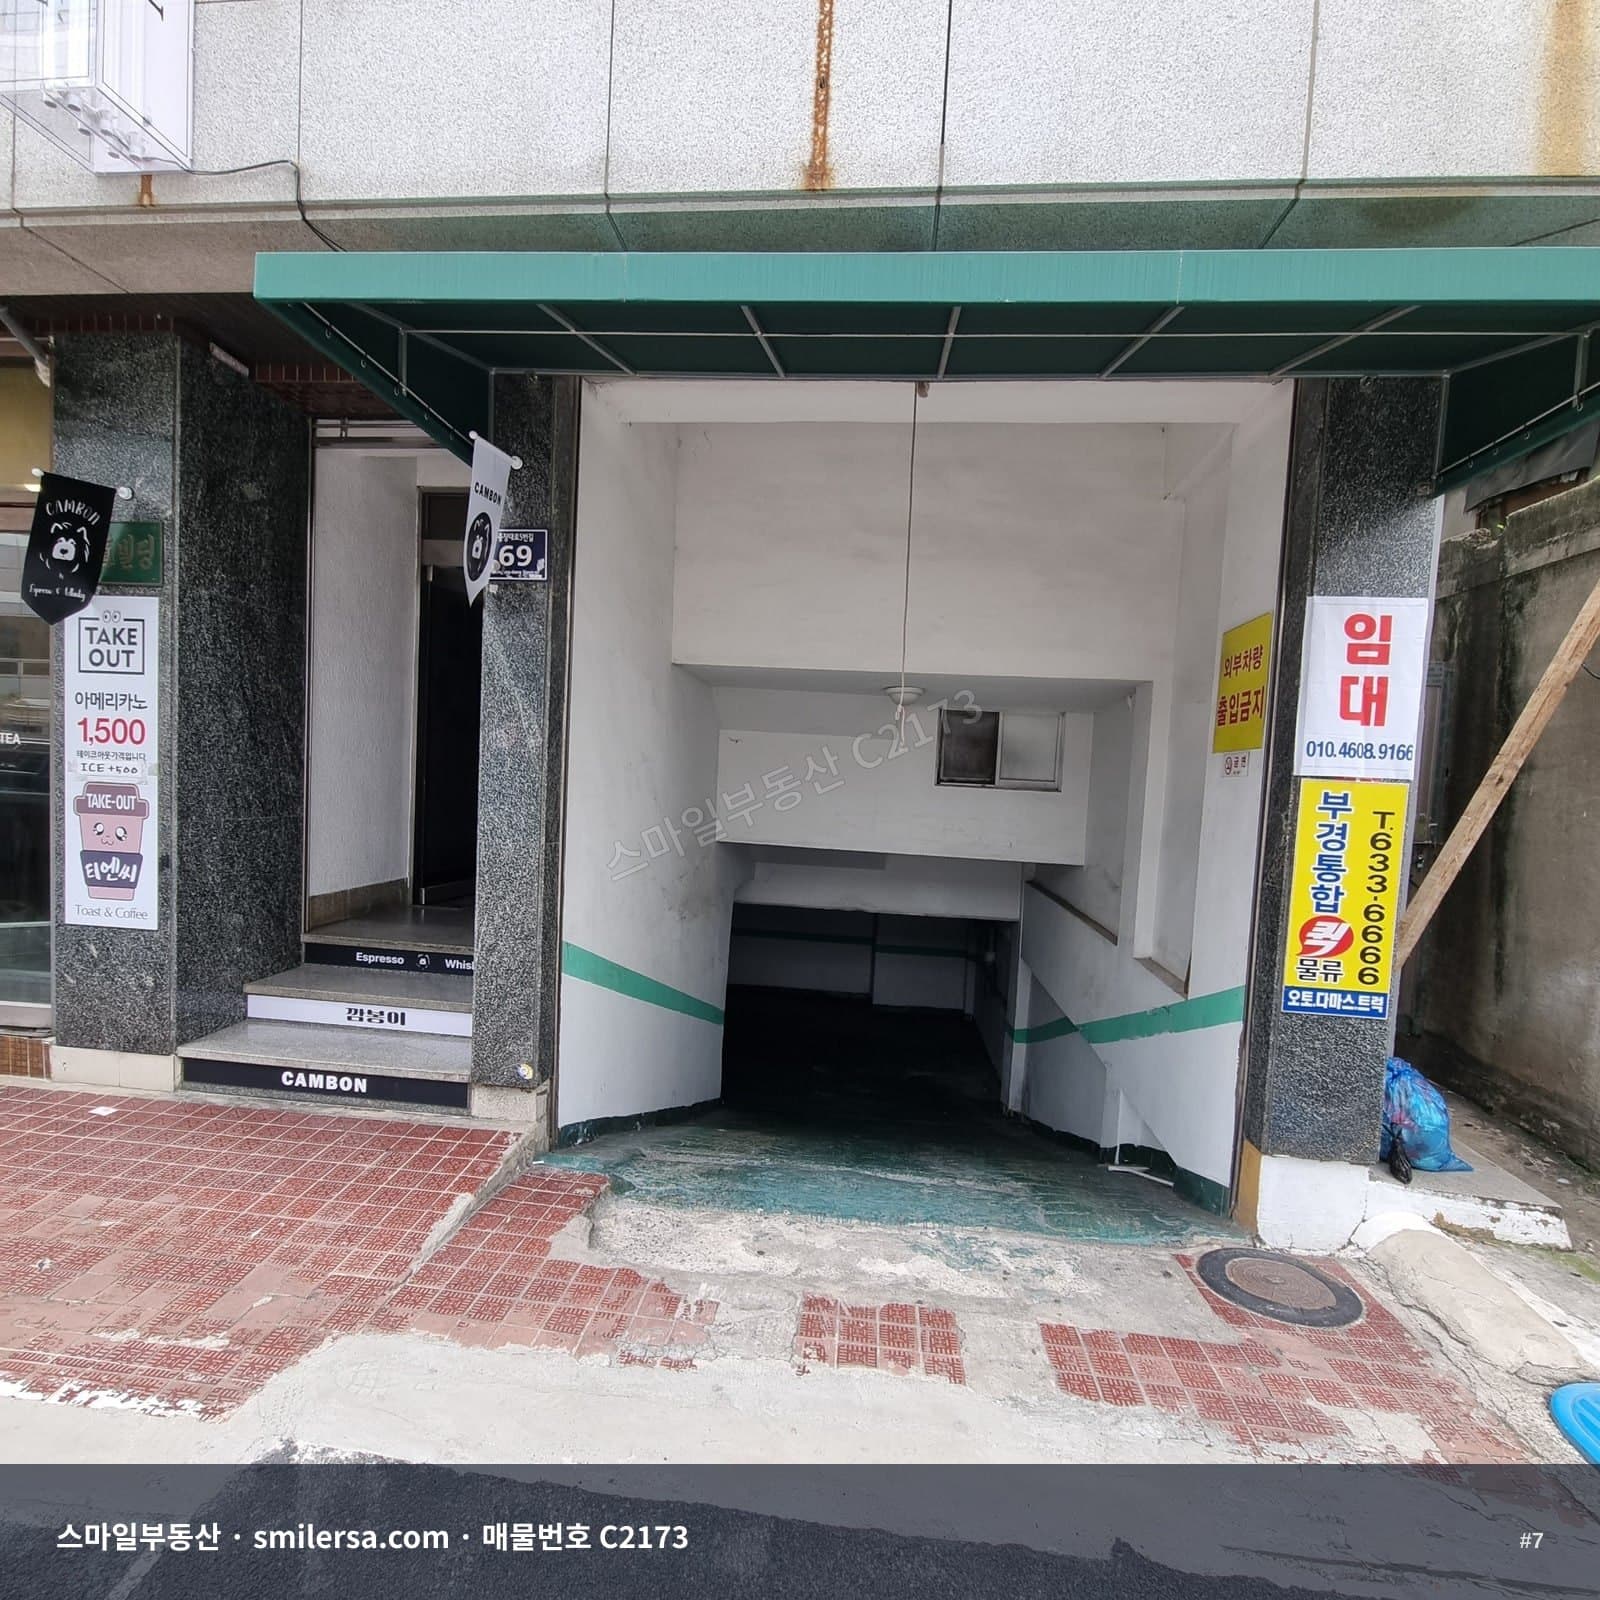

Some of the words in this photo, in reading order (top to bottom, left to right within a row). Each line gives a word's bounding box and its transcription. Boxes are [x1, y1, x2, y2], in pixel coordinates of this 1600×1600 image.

[474, 482, 502, 505] CAMBON
[45, 499, 101, 526] CAMBON
[499, 545, 533, 567] 69
[85, 627, 138, 646] TAKE
[89, 648, 135, 668] OUT
[1223, 645, 1264, 679] 외부차량
[1339, 613, 1393, 727] 임대
[75, 691, 148, 711] 아메리카노
[1216, 686, 1265, 727] 출입금지
[77, 717, 146, 746] 1,500
[1306, 740, 1414, 761] 010.4608.9166
[81, 762, 105, 773] ICE
[108, 764, 138, 774] +500
[86, 793, 137, 811] TAKE-OUT
[75, 904, 101, 917] Toast
[104, 908, 114, 918] &
[115, 907, 149, 919] Coffee
[355, 952, 405, 965] Espresso
[345, 1007, 406, 1026] 깜봉이
[281, 1071, 368, 1093] CAMBON
